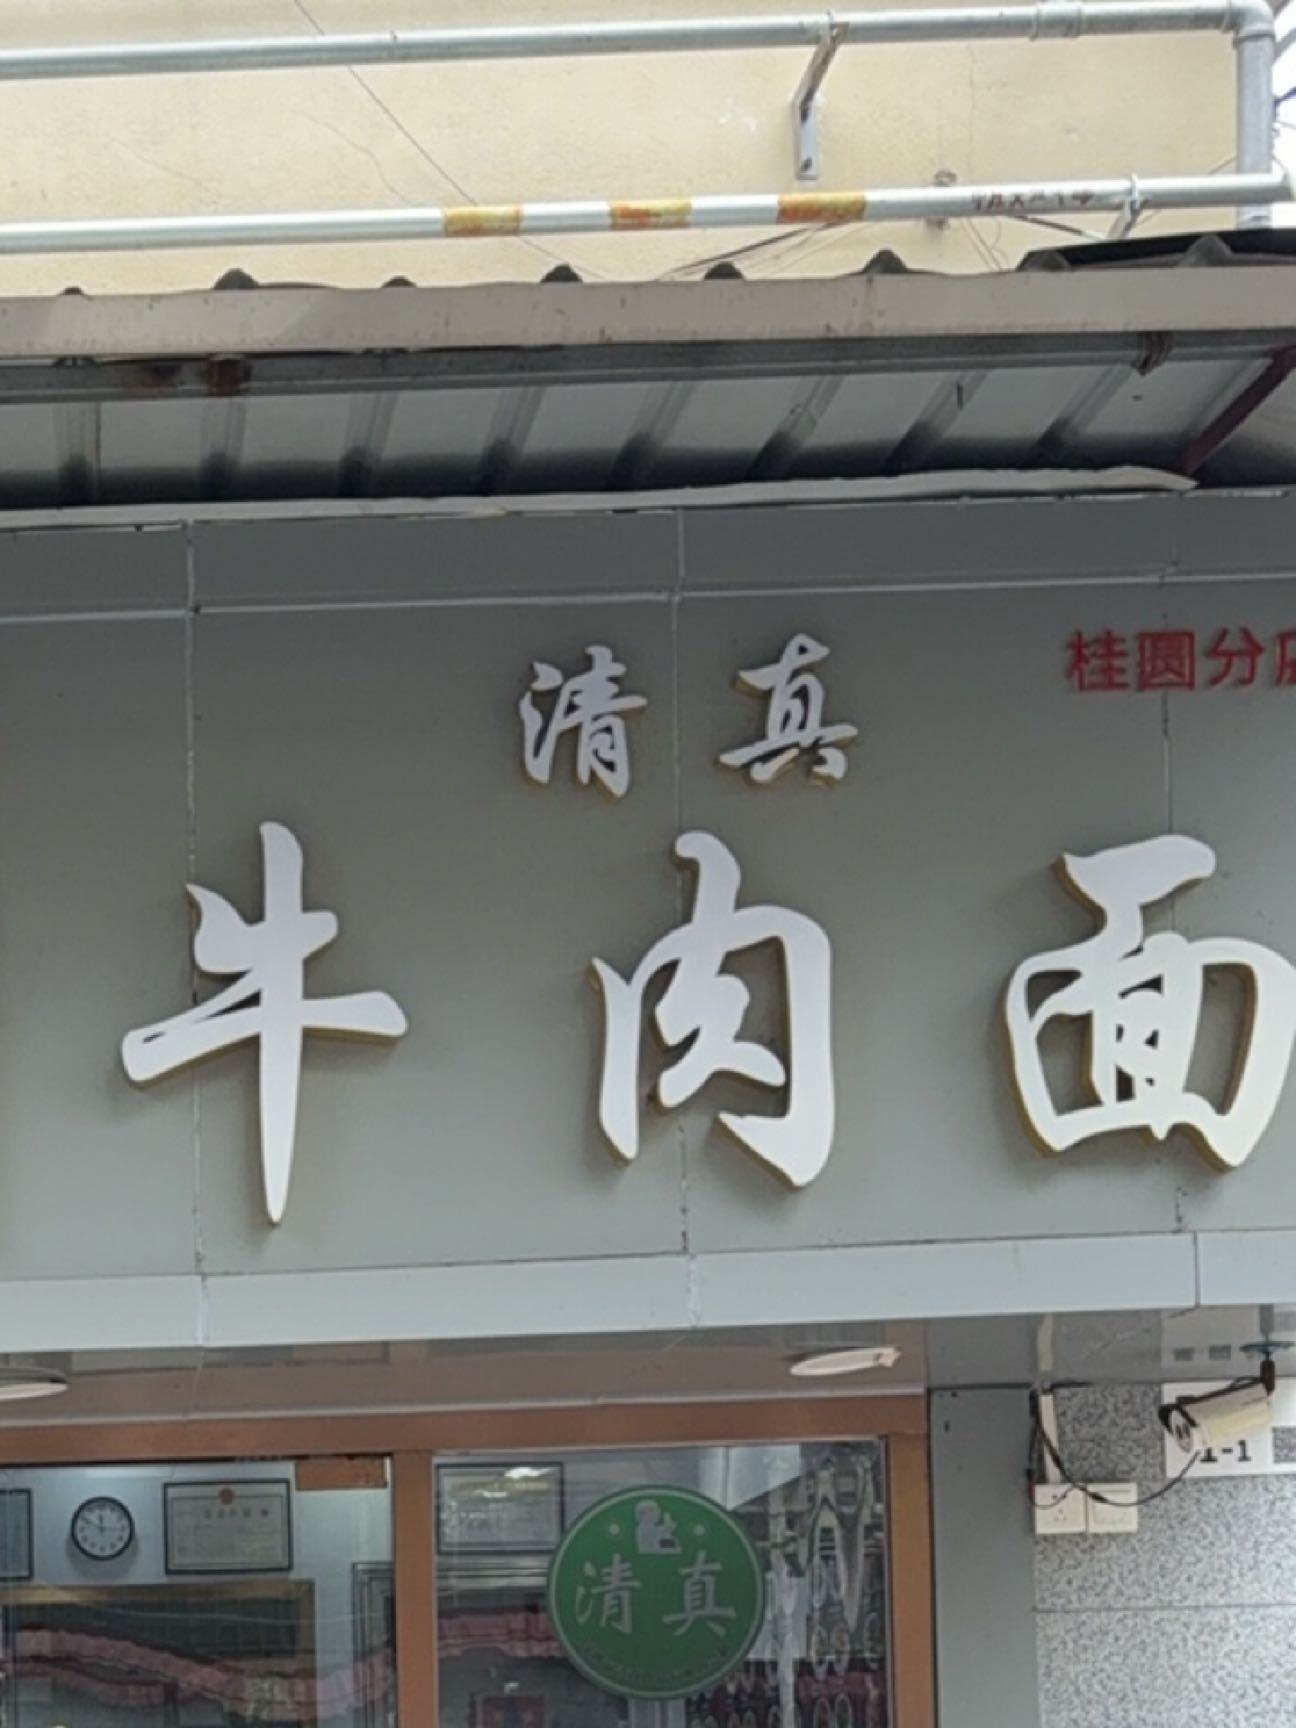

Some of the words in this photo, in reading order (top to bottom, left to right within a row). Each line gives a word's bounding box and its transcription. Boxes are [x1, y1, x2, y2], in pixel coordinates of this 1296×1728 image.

[518, 634, 857, 798] 清真
[121, 820, 1296, 1224] 牛肉面
[574, 1550, 737, 1637] 清真
